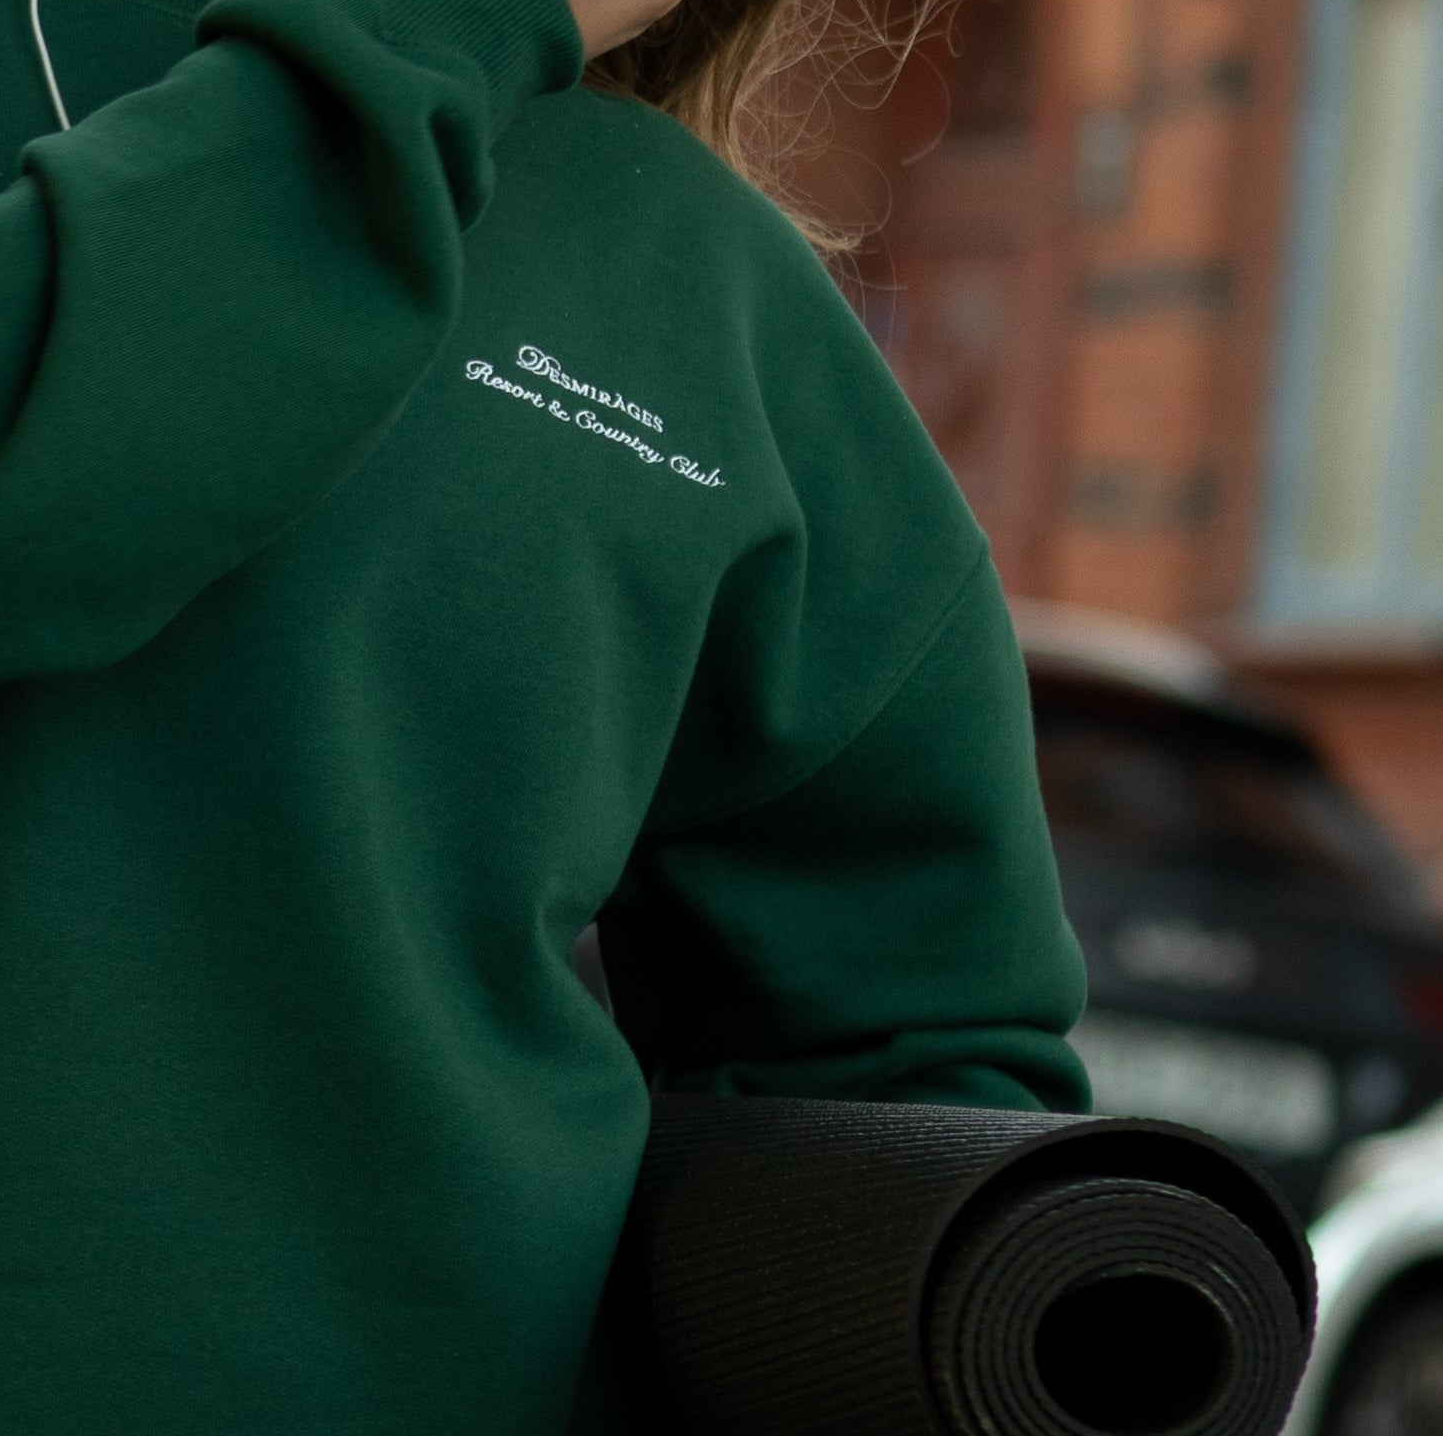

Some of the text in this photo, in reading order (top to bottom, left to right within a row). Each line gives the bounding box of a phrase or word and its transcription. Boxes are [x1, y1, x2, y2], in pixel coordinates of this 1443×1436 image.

[465, 360, 726, 487] Resort & Country Club
